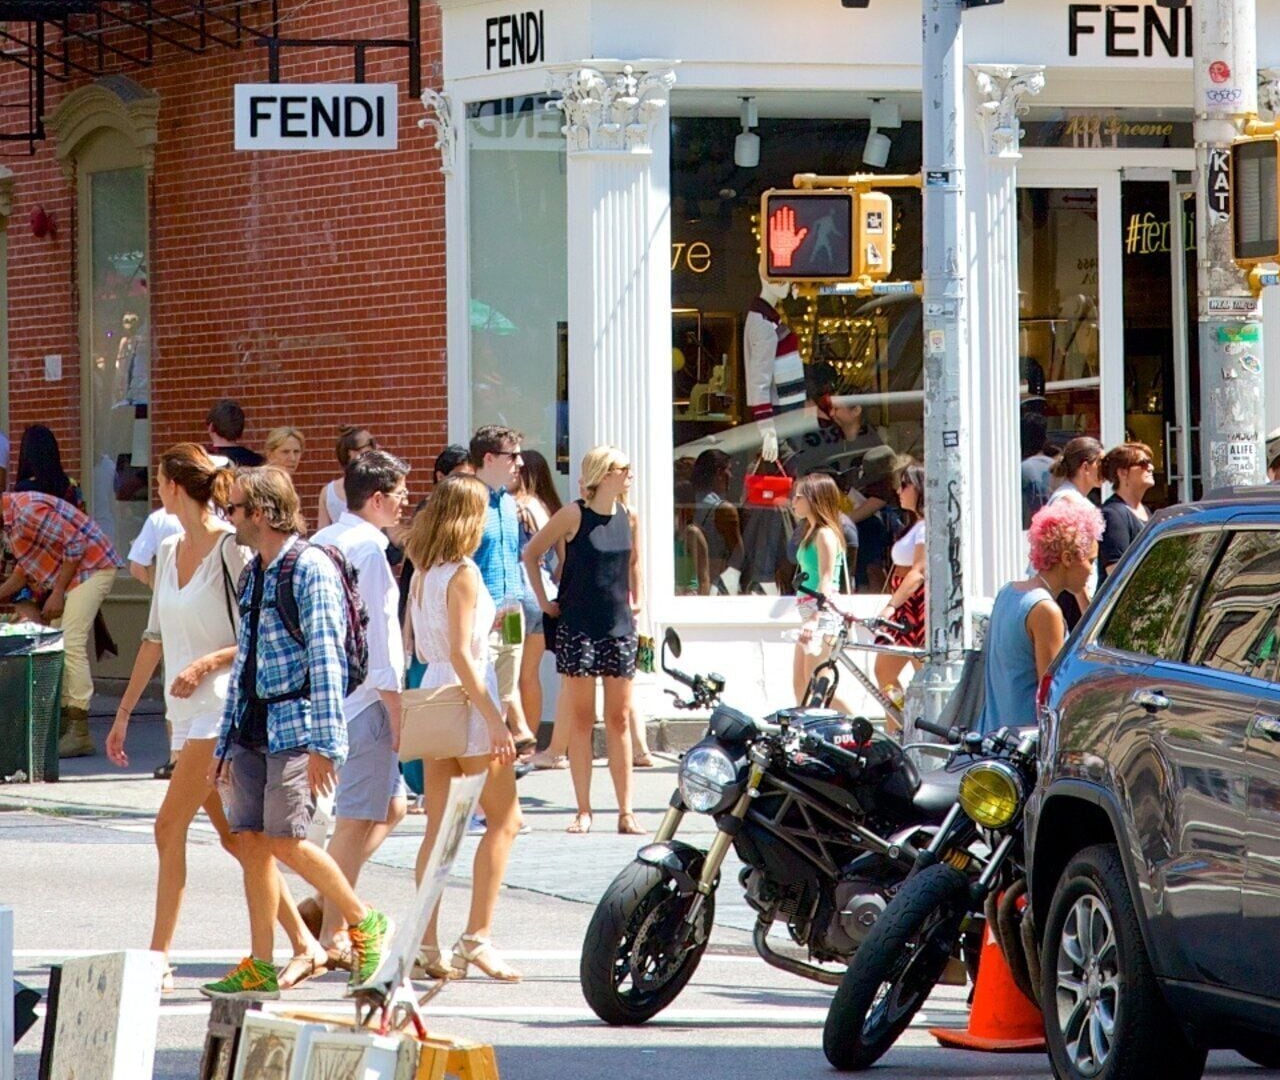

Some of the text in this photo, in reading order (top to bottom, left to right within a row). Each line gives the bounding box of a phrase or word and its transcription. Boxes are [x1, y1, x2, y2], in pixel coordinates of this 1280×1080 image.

[486, 9, 545, 70] FENDI
[1068, 4, 1193, 57] FEN
[249, 96, 385, 138] FENDI
